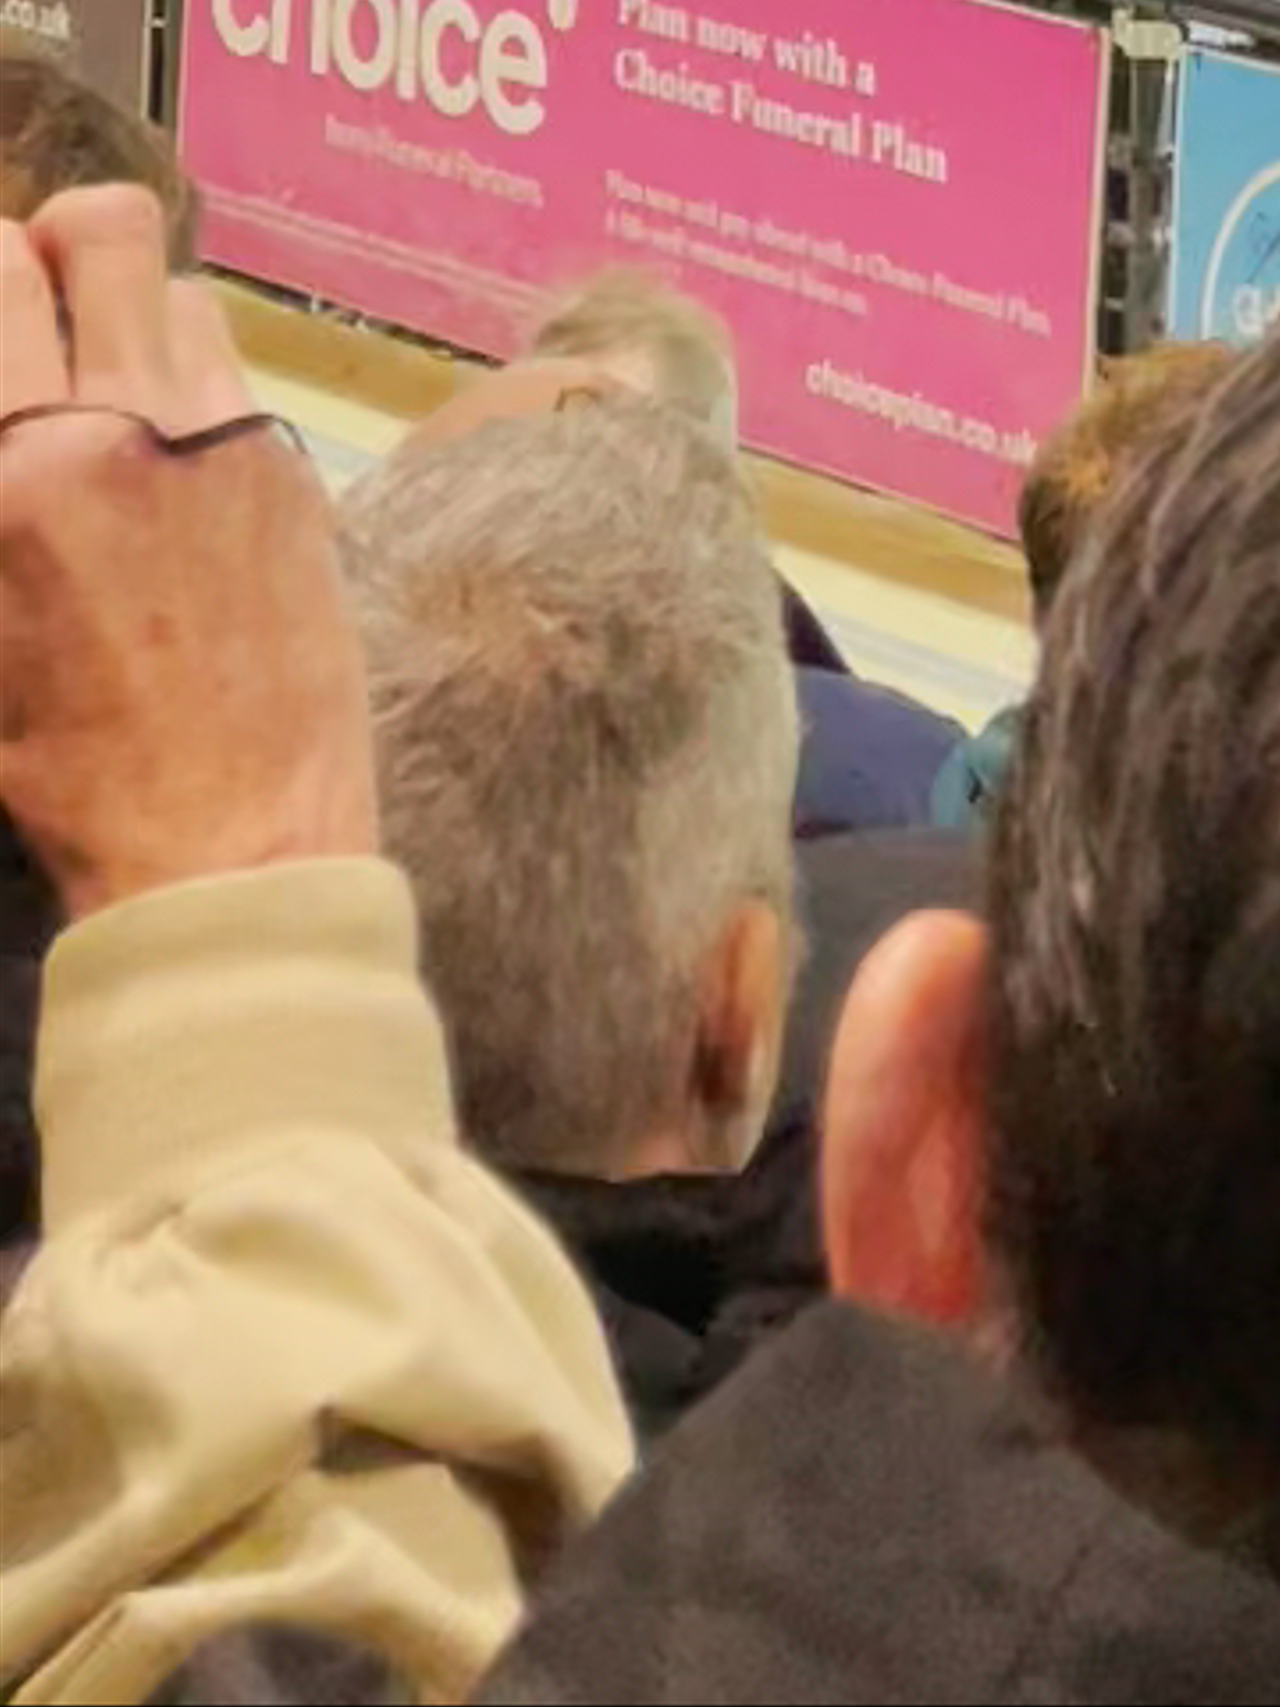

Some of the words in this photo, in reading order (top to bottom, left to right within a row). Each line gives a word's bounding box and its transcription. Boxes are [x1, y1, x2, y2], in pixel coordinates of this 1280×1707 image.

[696, 16, 767, 61] now
[773, 31, 846, 88] with
[854, 61, 876, 97] a
[613, 48, 726, 117] Choice
[730, 79, 861, 158] Funeral
[870, 119, 947, 185] Plan
